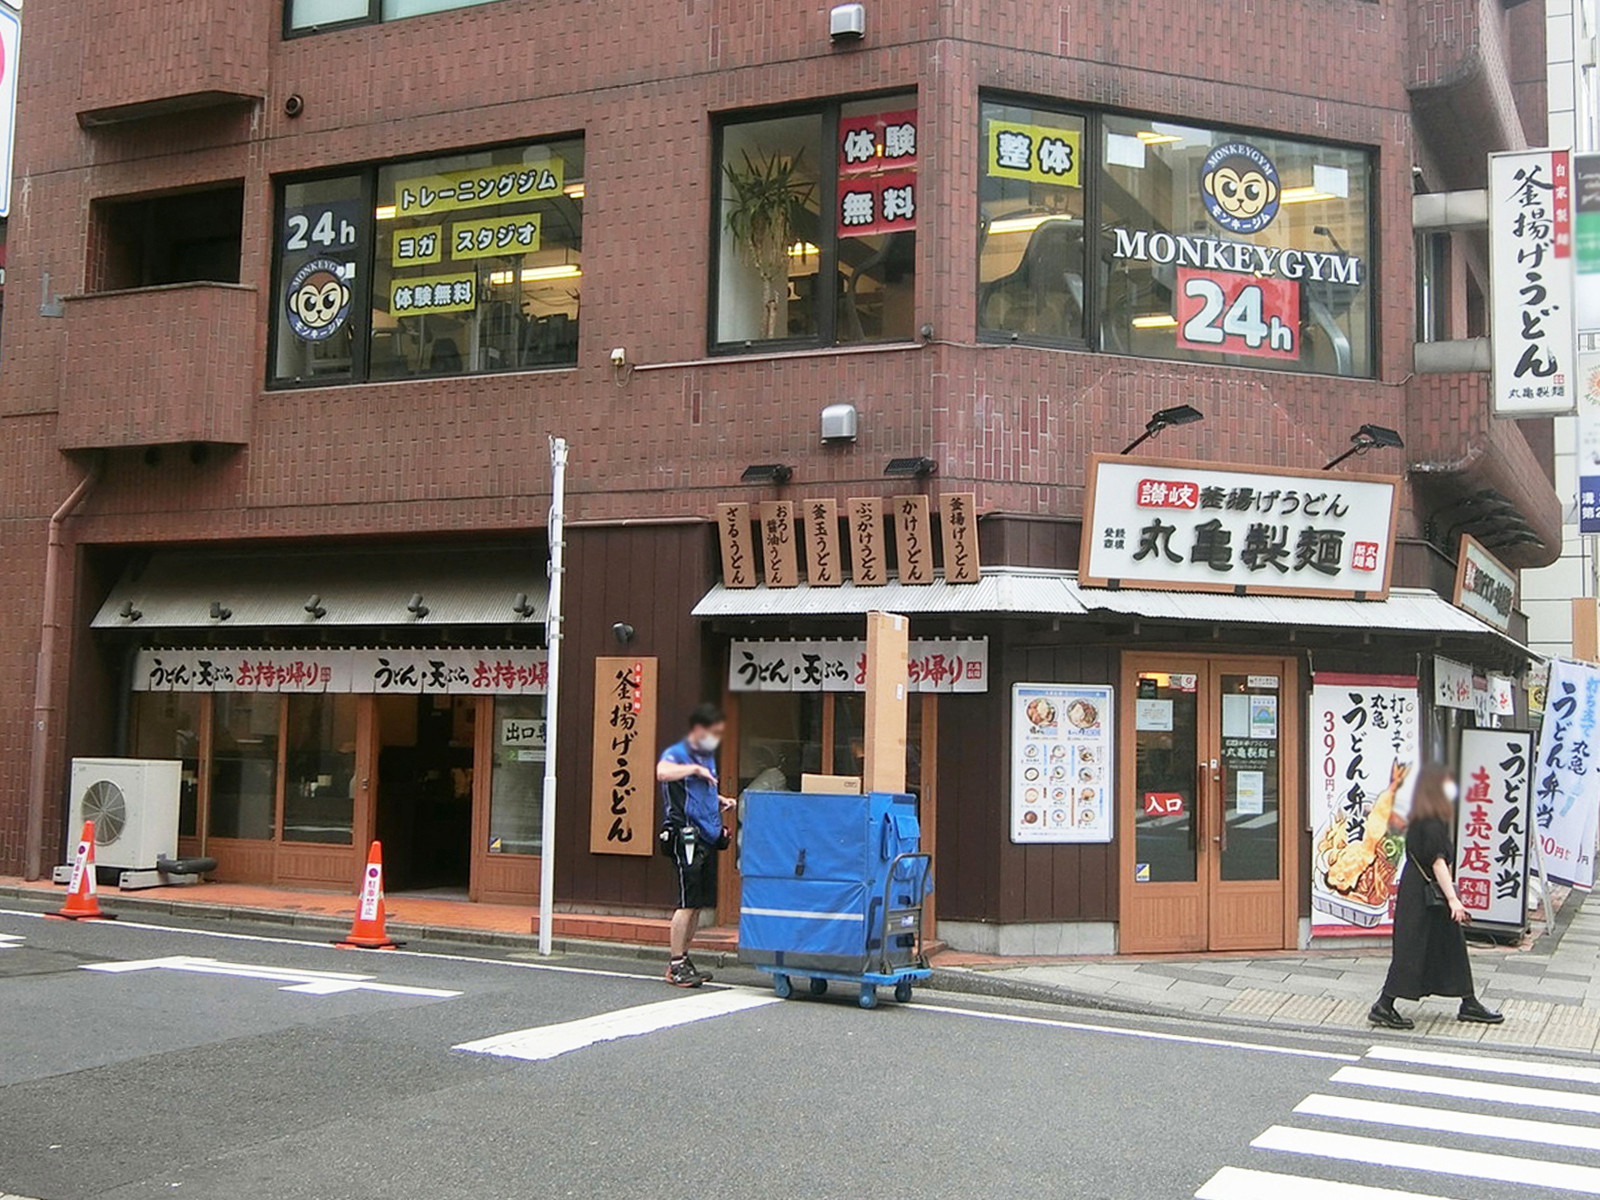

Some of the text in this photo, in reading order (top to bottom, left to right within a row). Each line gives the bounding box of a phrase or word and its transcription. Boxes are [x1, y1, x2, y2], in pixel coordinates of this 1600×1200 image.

[844, 123, 917, 164] 体験
[998, 132, 1072, 174] 整体
[1207, 143, 1274, 177] MONKEYGYM
[402, 170, 557, 210] トレーニングジム
[842, 186, 916, 225] 無料
[287, 211, 355, 250] 24h
[1211, 204, 1271, 231] モンキージム
[399, 222, 535, 258] ヨガ スタジオ
[1113, 229, 1360, 285] MONKEYGYM
[292, 260, 340, 286] MONKEYG
[1505, 165, 1558, 378] 釜揚げうどん
[394, 281, 471, 310] 体験無料
[1184, 278, 1293, 351] 24h
[1200, 485, 1349, 518] 釜揚げうどん
[812, 504, 831, 582] 釜玉うどん
[902, 500, 923, 580] かけうどん
[950, 498, 968, 579] 釜揚げうどん
[1133, 518, 1346, 577] 丸亀製麺
[236, 660, 319, 688] お持ち帰り
[854, 652, 963, 688] おち帰り
[1371, 693, 1388, 730] 丸亀
[1390, 693, 1407, 754] 打ち立て
[607, 668, 640, 843] 釜揚げうどん
[1342, 692, 1370, 843] うどん弁当
[1536, 681, 1576, 829] うどん弁当
[1147, 796, 1183, 813] 入口
[1459, 766, 1494, 874] 直売店
[1494, 743, 1527, 899] うどん弁当
